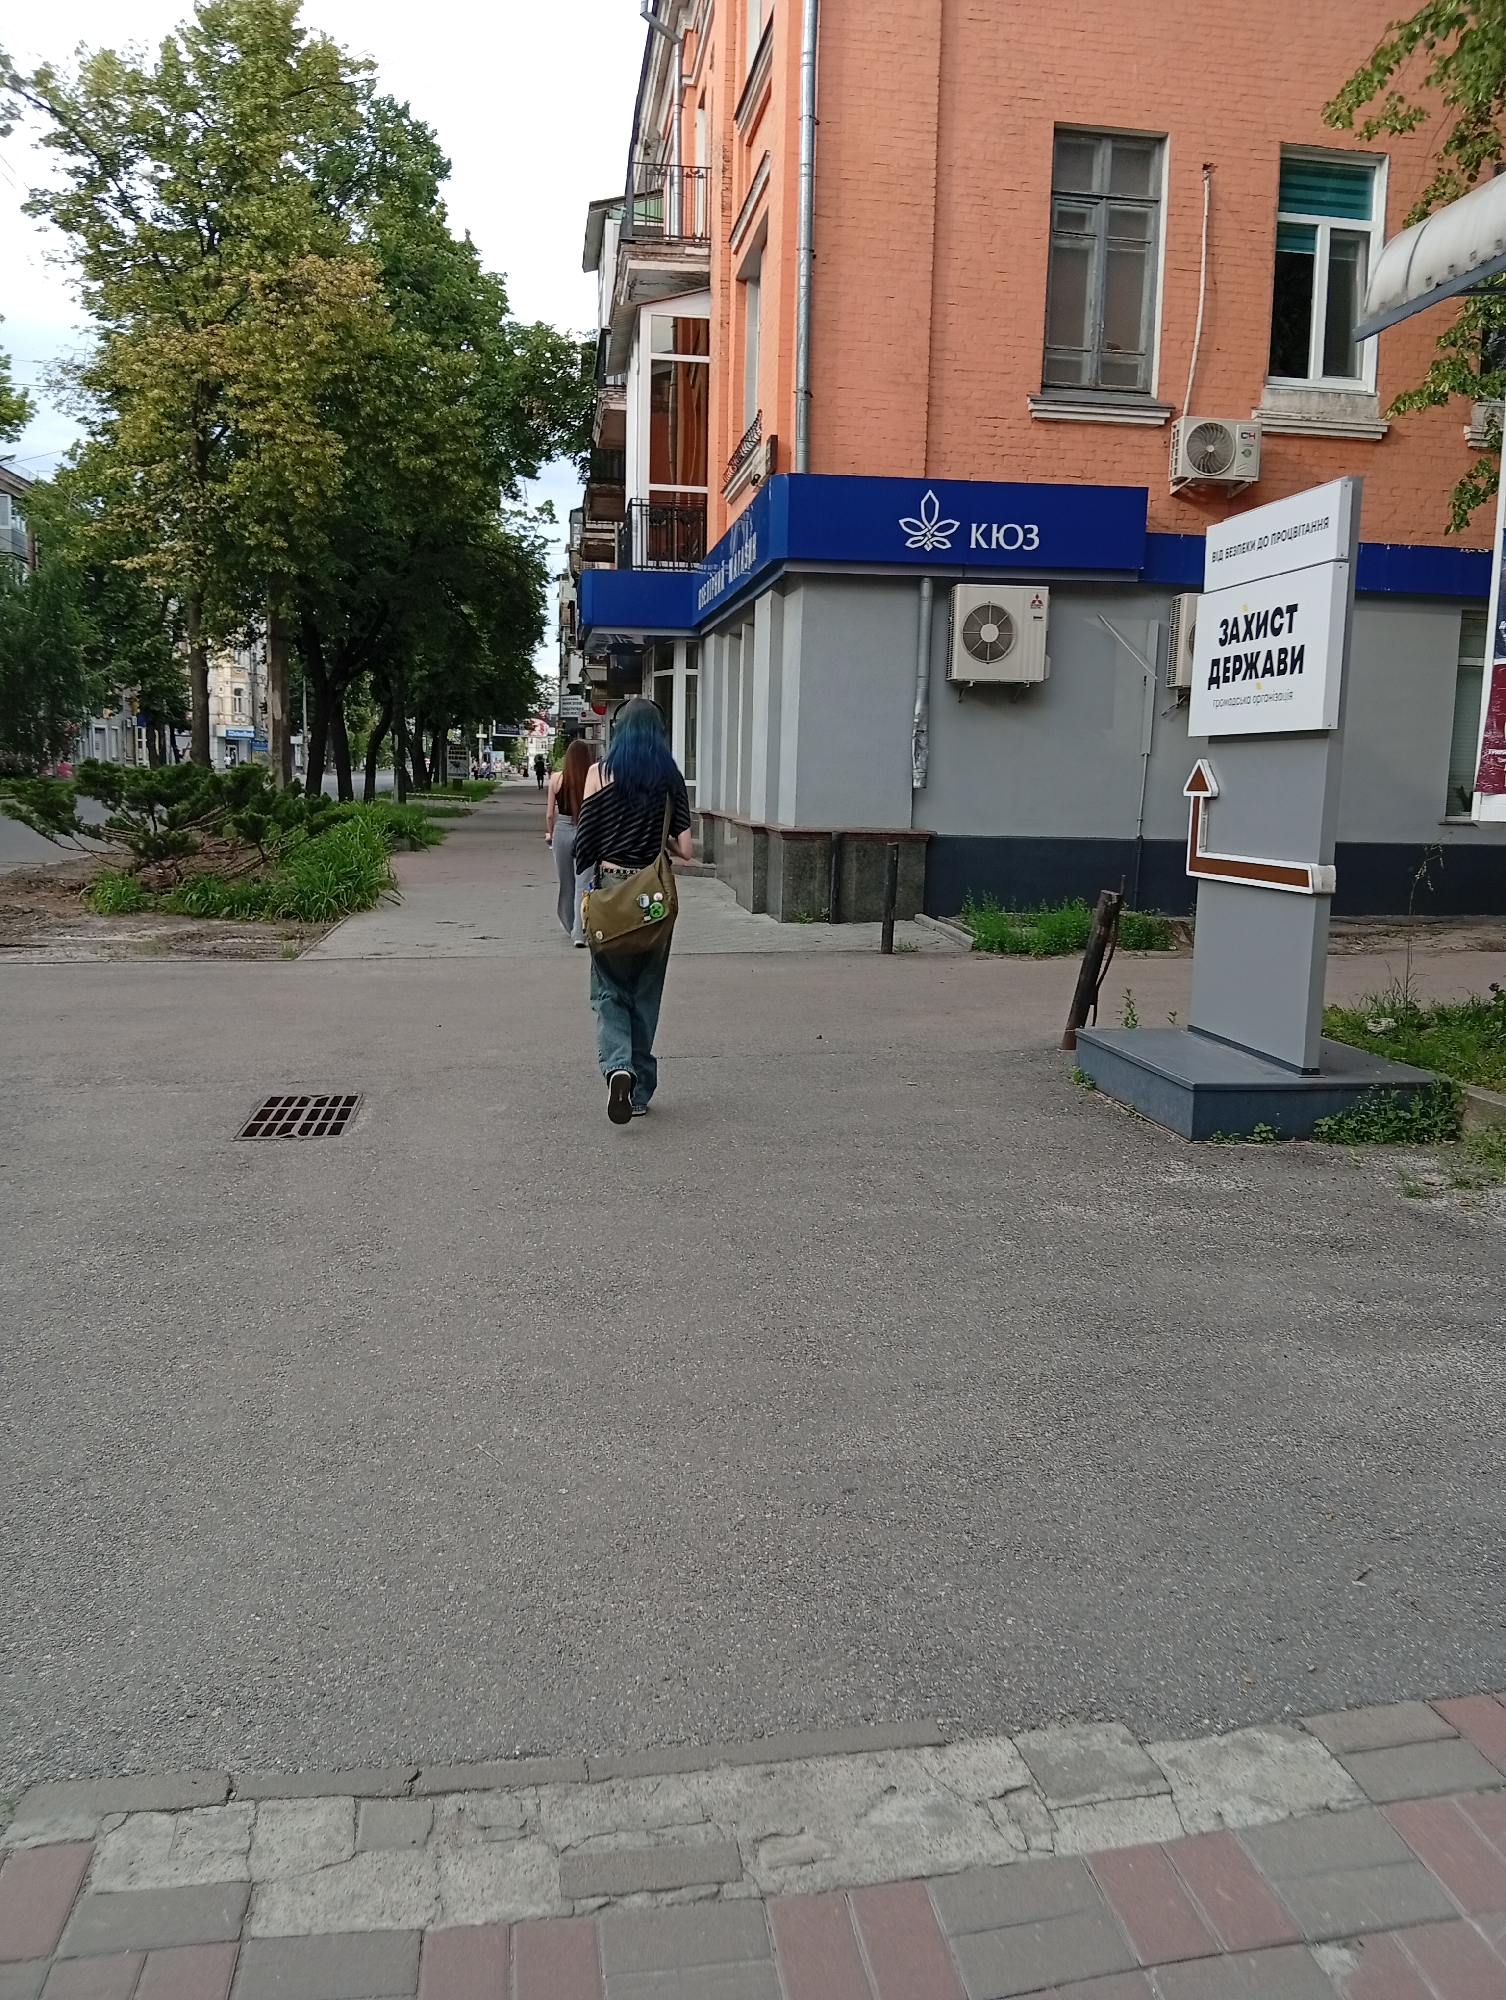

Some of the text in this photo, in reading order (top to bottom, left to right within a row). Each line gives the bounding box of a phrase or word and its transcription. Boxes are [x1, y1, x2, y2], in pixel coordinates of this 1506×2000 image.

[969, 522, 1041, 552] КЮЗ
[1211, 516, 1330, 563] ВІД БЕЗПЕКИ ДО ПРОЦВІТАННЯ
[1218, 603, 1299, 648] ЗАХИСТ
[1207, 644, 1306, 691] ДЕРЖАВИ
[1212, 688, 1294, 710] громадська організація
